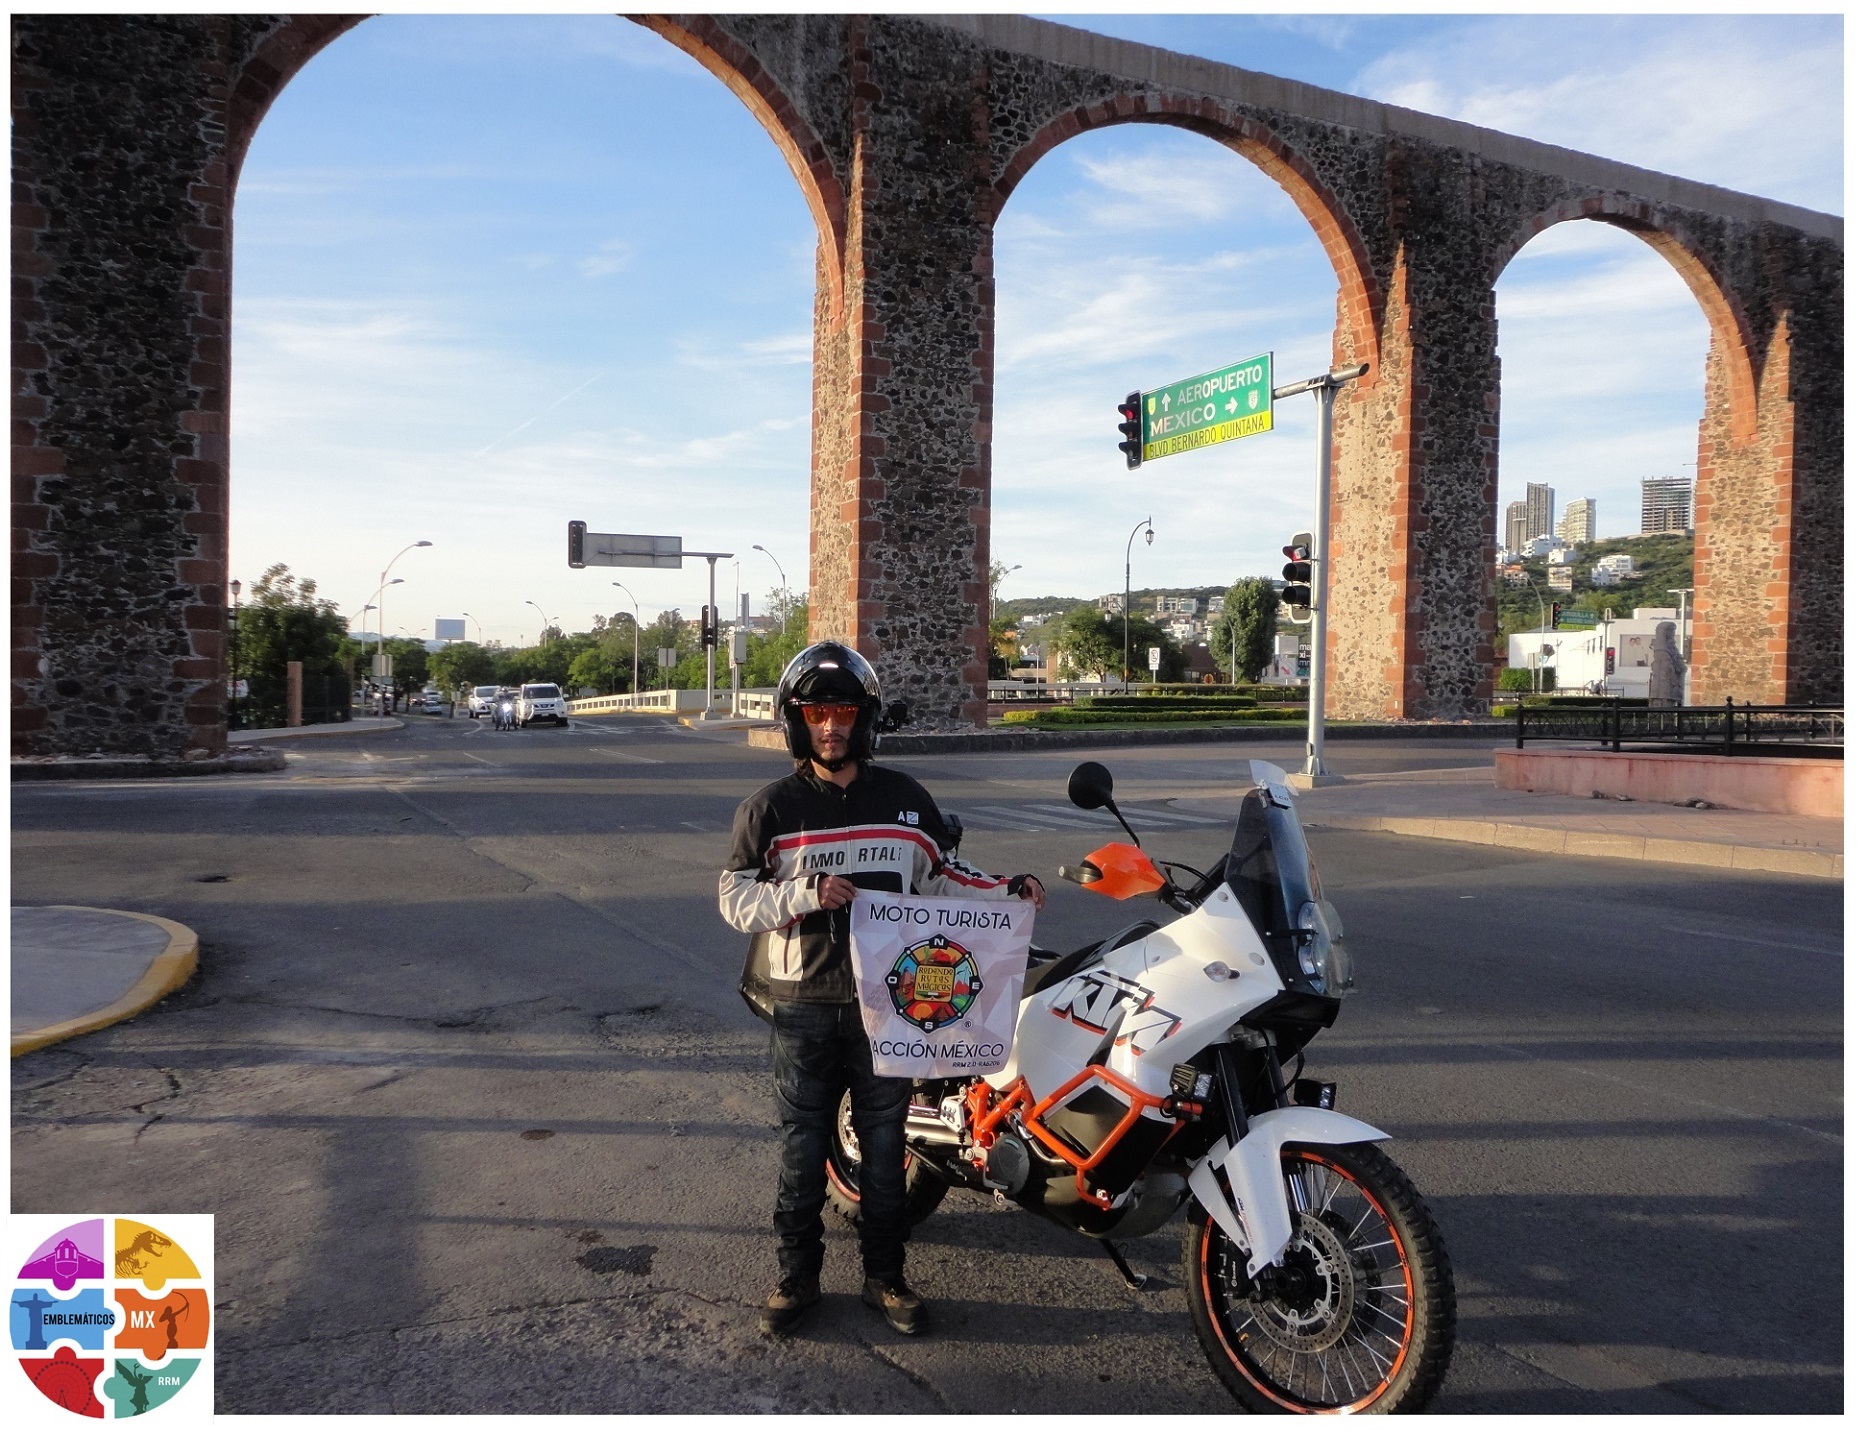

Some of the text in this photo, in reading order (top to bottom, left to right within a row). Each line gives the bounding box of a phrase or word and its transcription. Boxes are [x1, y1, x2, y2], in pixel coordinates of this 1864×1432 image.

[1177, 365, 1263, 407] AEROPUERTO
[1150, 402, 1216, 436] MEXICO
[1149, 415, 1264, 459] BLVD BERNARDO QUINTANA
[869, 903, 1012, 931] MOTO TURISTA
[934, 938, 944, 946] N
[971, 982, 980, 990] E
[924, 1021, 934, 1030] S
[1047, 970, 1182, 1056] KTM
[872, 1039, 1004, 1059] ACCIÓN MÉXICO
